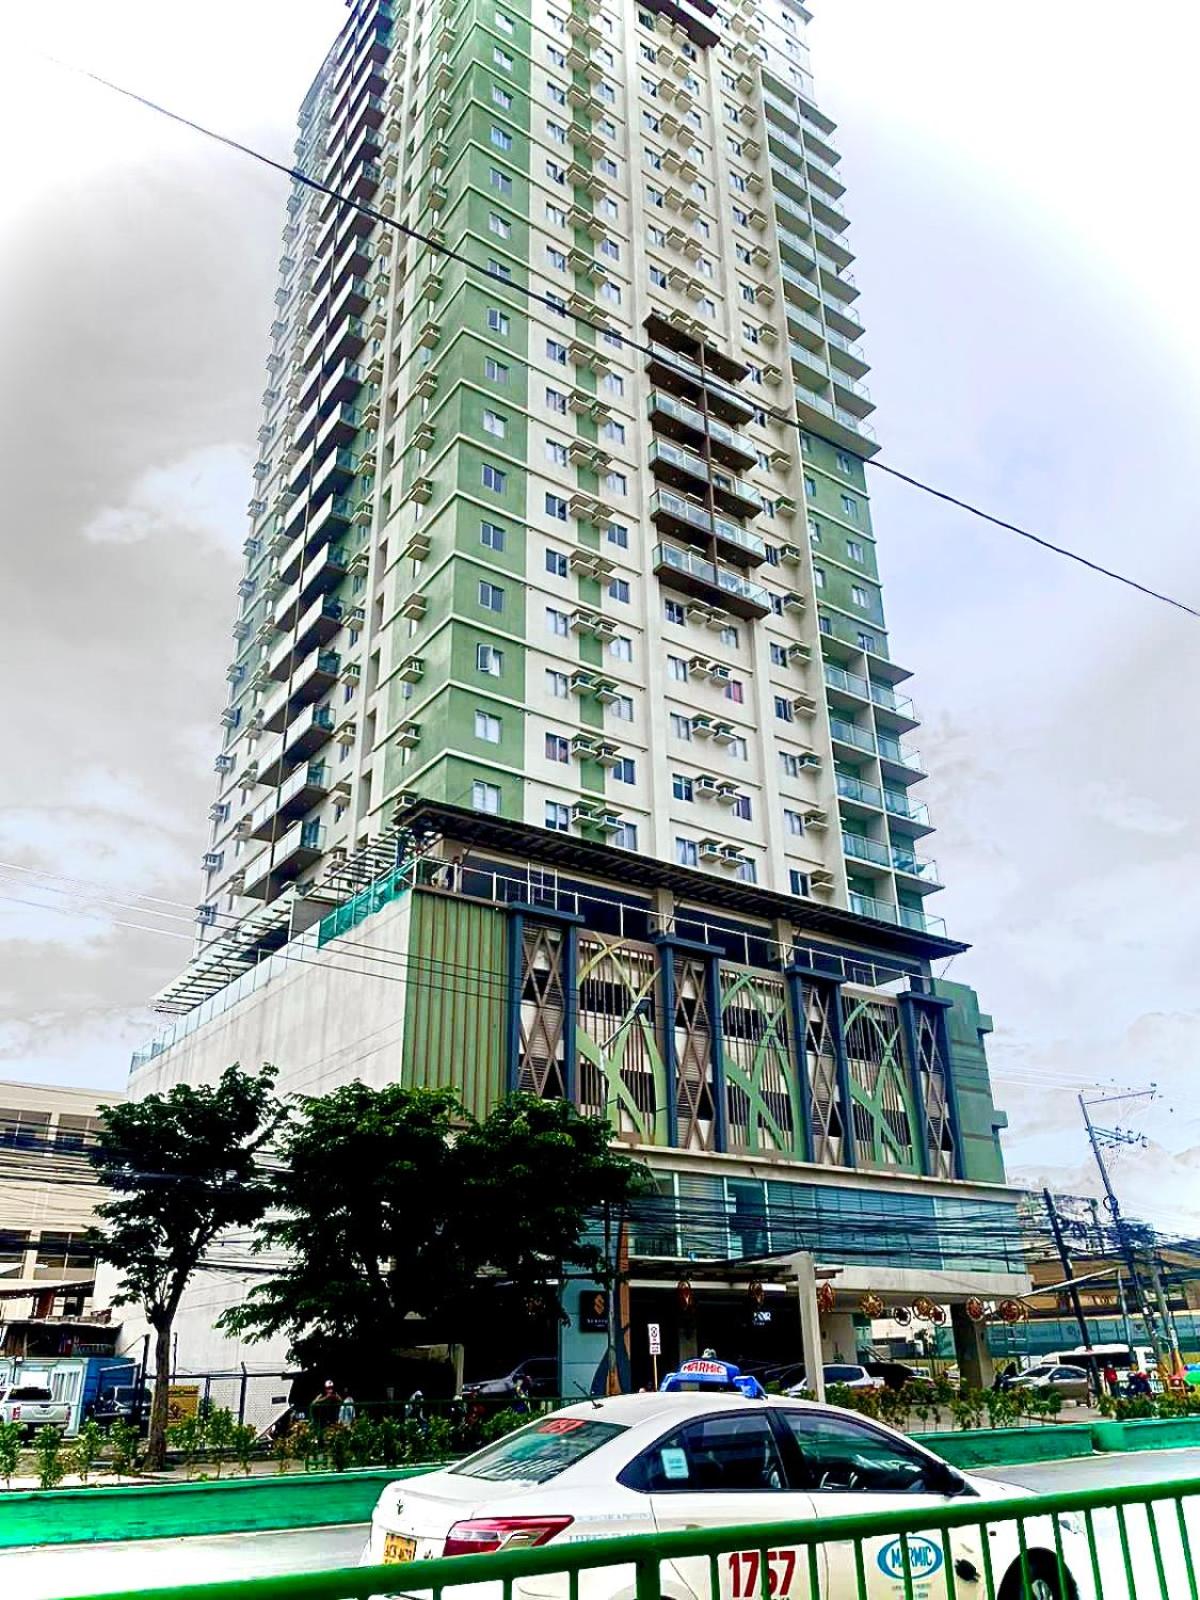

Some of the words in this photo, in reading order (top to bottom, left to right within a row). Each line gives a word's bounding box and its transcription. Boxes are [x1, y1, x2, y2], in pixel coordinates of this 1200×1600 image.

[683, 1362, 725, 1373] MARMIC
[891, 1545, 933, 1568] MRMIC
[729, 1551, 796, 1598] 1757
